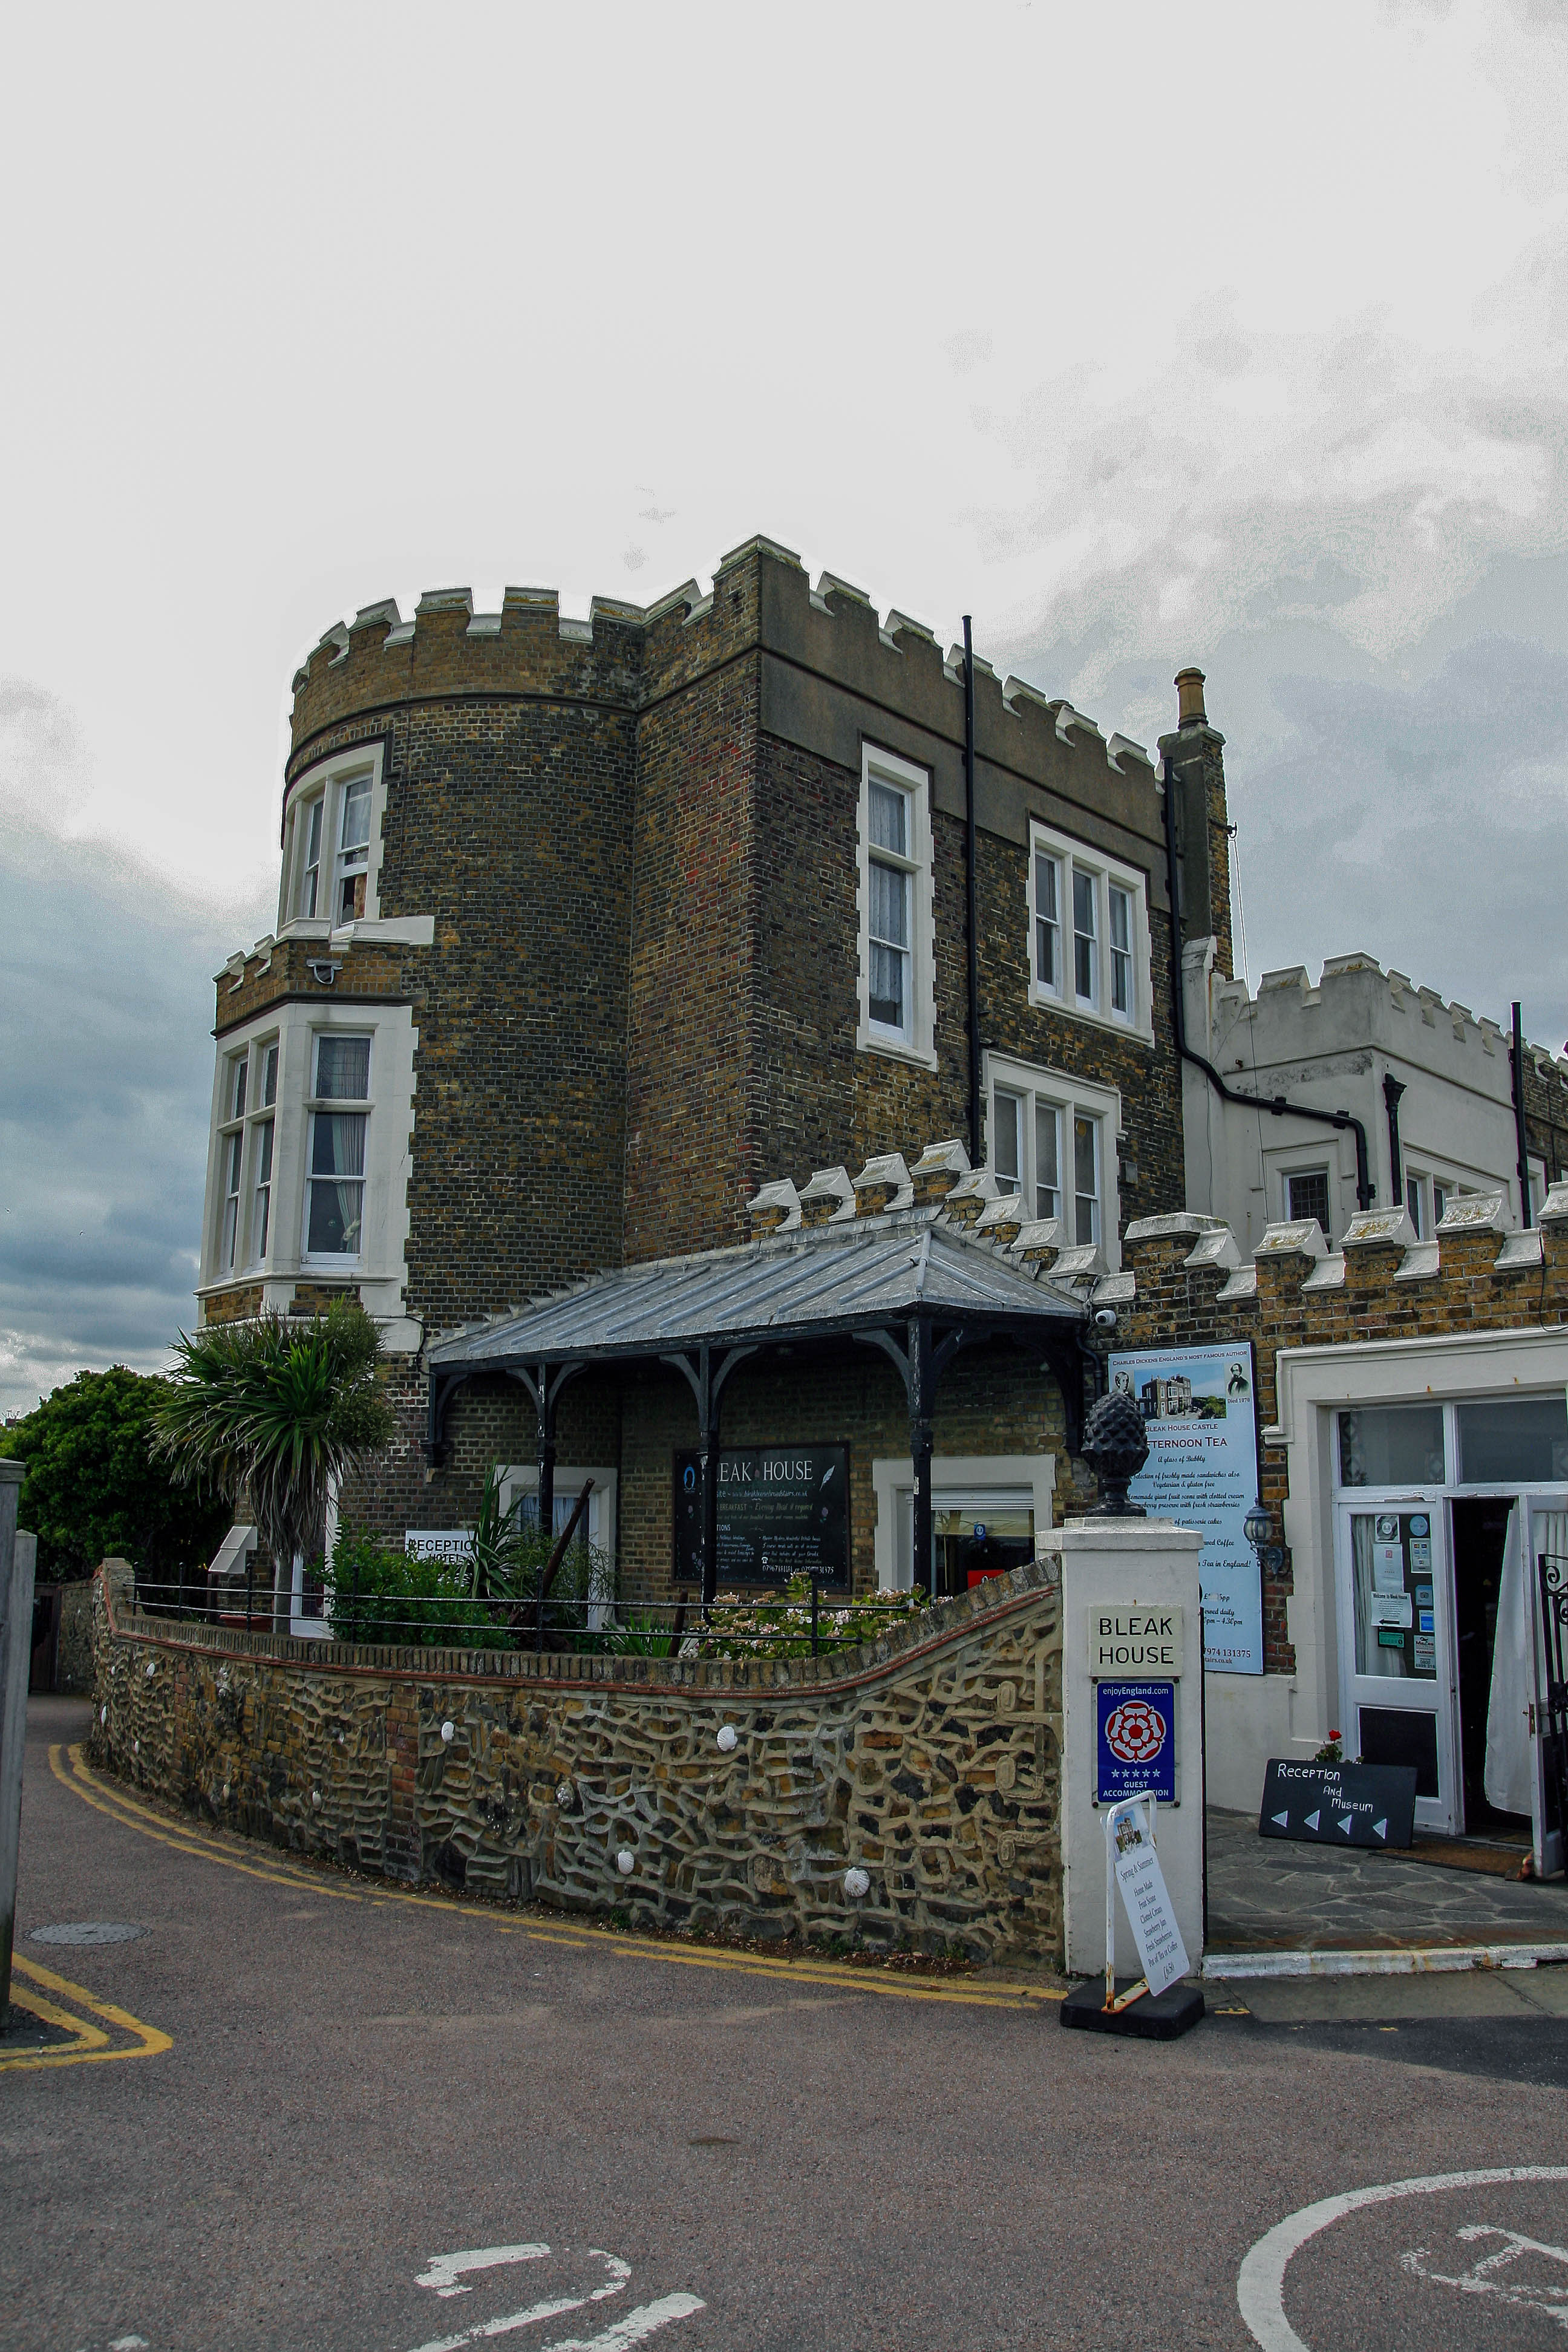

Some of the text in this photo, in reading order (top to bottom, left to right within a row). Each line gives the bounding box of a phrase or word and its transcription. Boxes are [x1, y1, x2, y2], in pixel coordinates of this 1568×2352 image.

[1145, 1425, 1166, 1434] BLEAK
[1192, 1423, 1218, 1431] CASTLE
[1147, 1436, 1227, 1449] FTERNOON TEA
[1186, 1455, 1206, 1463] Bubbly
[763, 1460, 814, 1481] HOUSE
[1161, 1472, 1180, 1481] freshly
[1187, 1480, 1203, 1489] gluten
[1204, 1480, 1215, 1489] free
[1192, 1501, 1206, 1510] fresh
[1181, 1518, 1206, 1526] patisserie
[1217, 1538, 1235, 1547] Coffee
[1223, 1559, 1251, 1569] England!
[1220, 1608, 1235, 1617] daily
[1099, 1617, 1174, 1636] BLEAK
[1099, 1645, 1174, 1665] HOUSE
[1223, 1648, 1251, 1658] 131375
[1102, 1686, 1169, 1696] enjoyEngland.com
